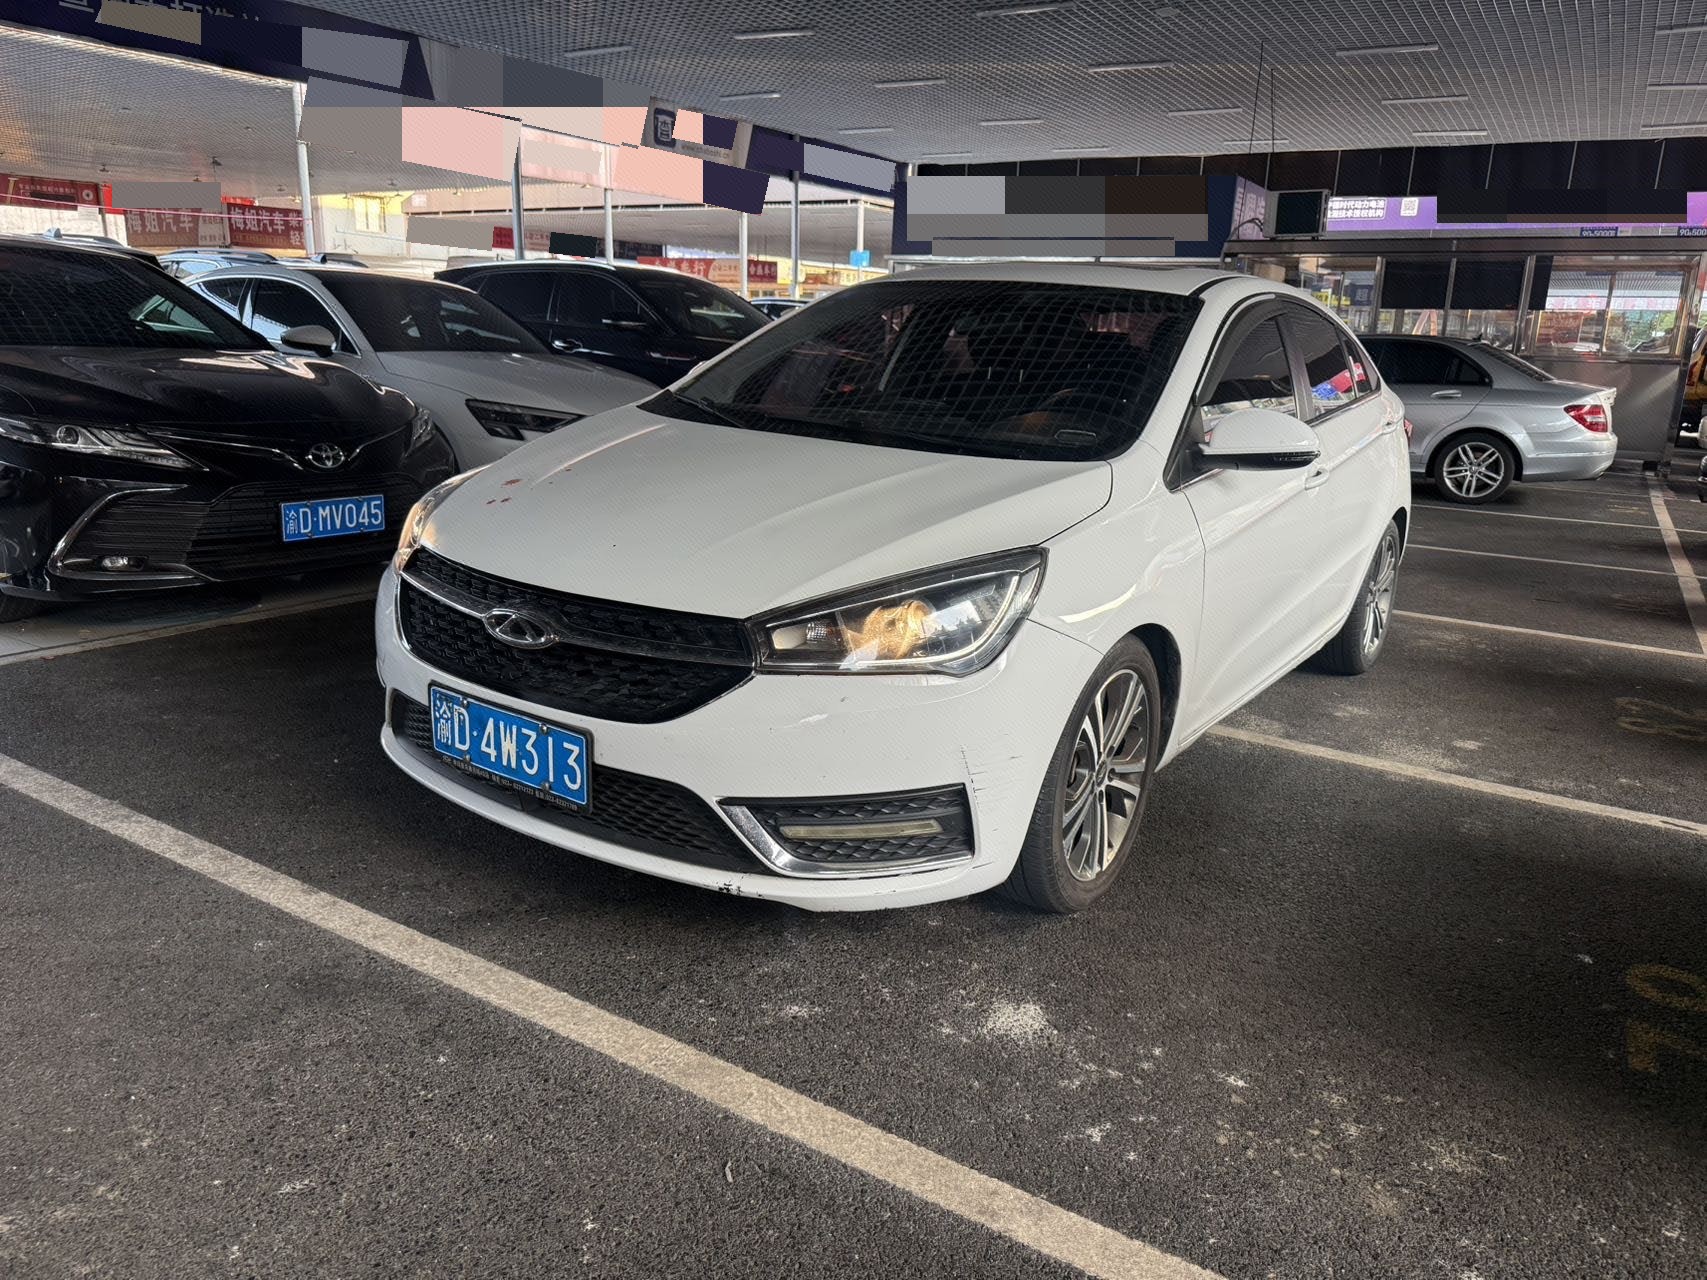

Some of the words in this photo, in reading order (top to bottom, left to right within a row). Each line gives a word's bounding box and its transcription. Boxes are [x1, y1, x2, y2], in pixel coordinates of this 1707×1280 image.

[230, 205, 285, 234] 梅姐汽车
[288, 211, 304, 227] 柴
[289, 230, 304, 245] 轻
